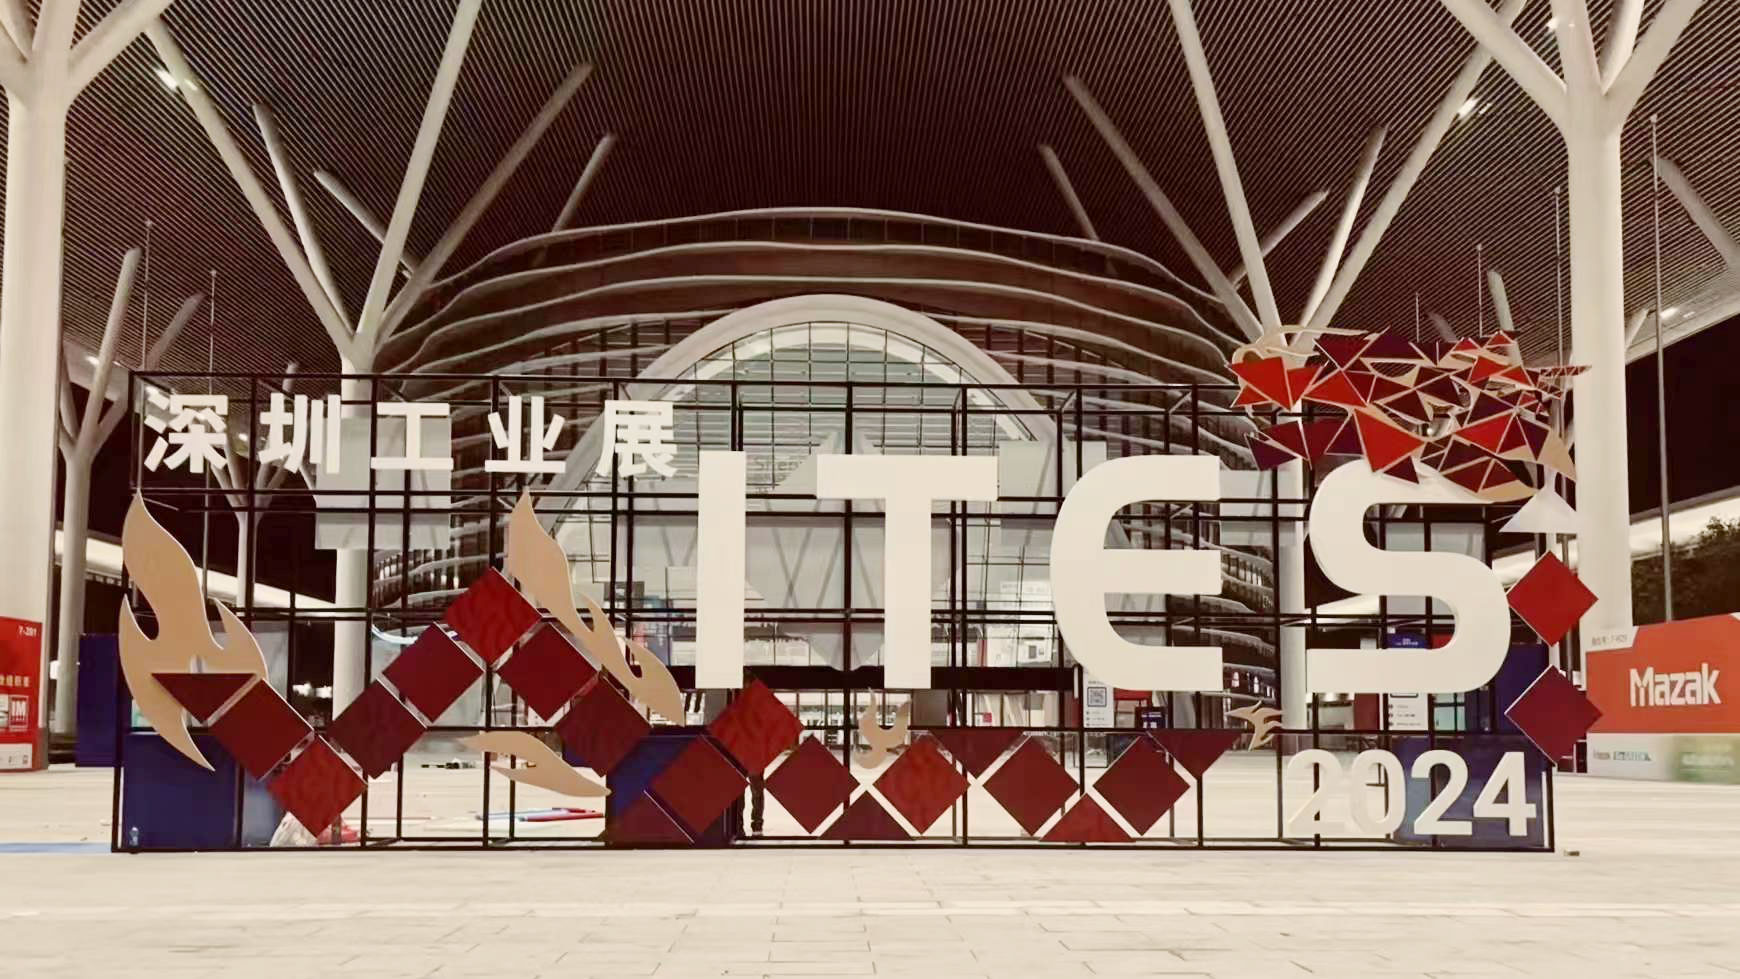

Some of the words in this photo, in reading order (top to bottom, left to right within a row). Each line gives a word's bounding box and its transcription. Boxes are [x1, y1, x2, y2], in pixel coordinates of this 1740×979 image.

[144, 393, 677, 477] 深圳工业展
[695, 450, 1510, 693] ITES
[1630, 662, 1721, 707] Mazak
[1286, 749, 1537, 837] 2024
